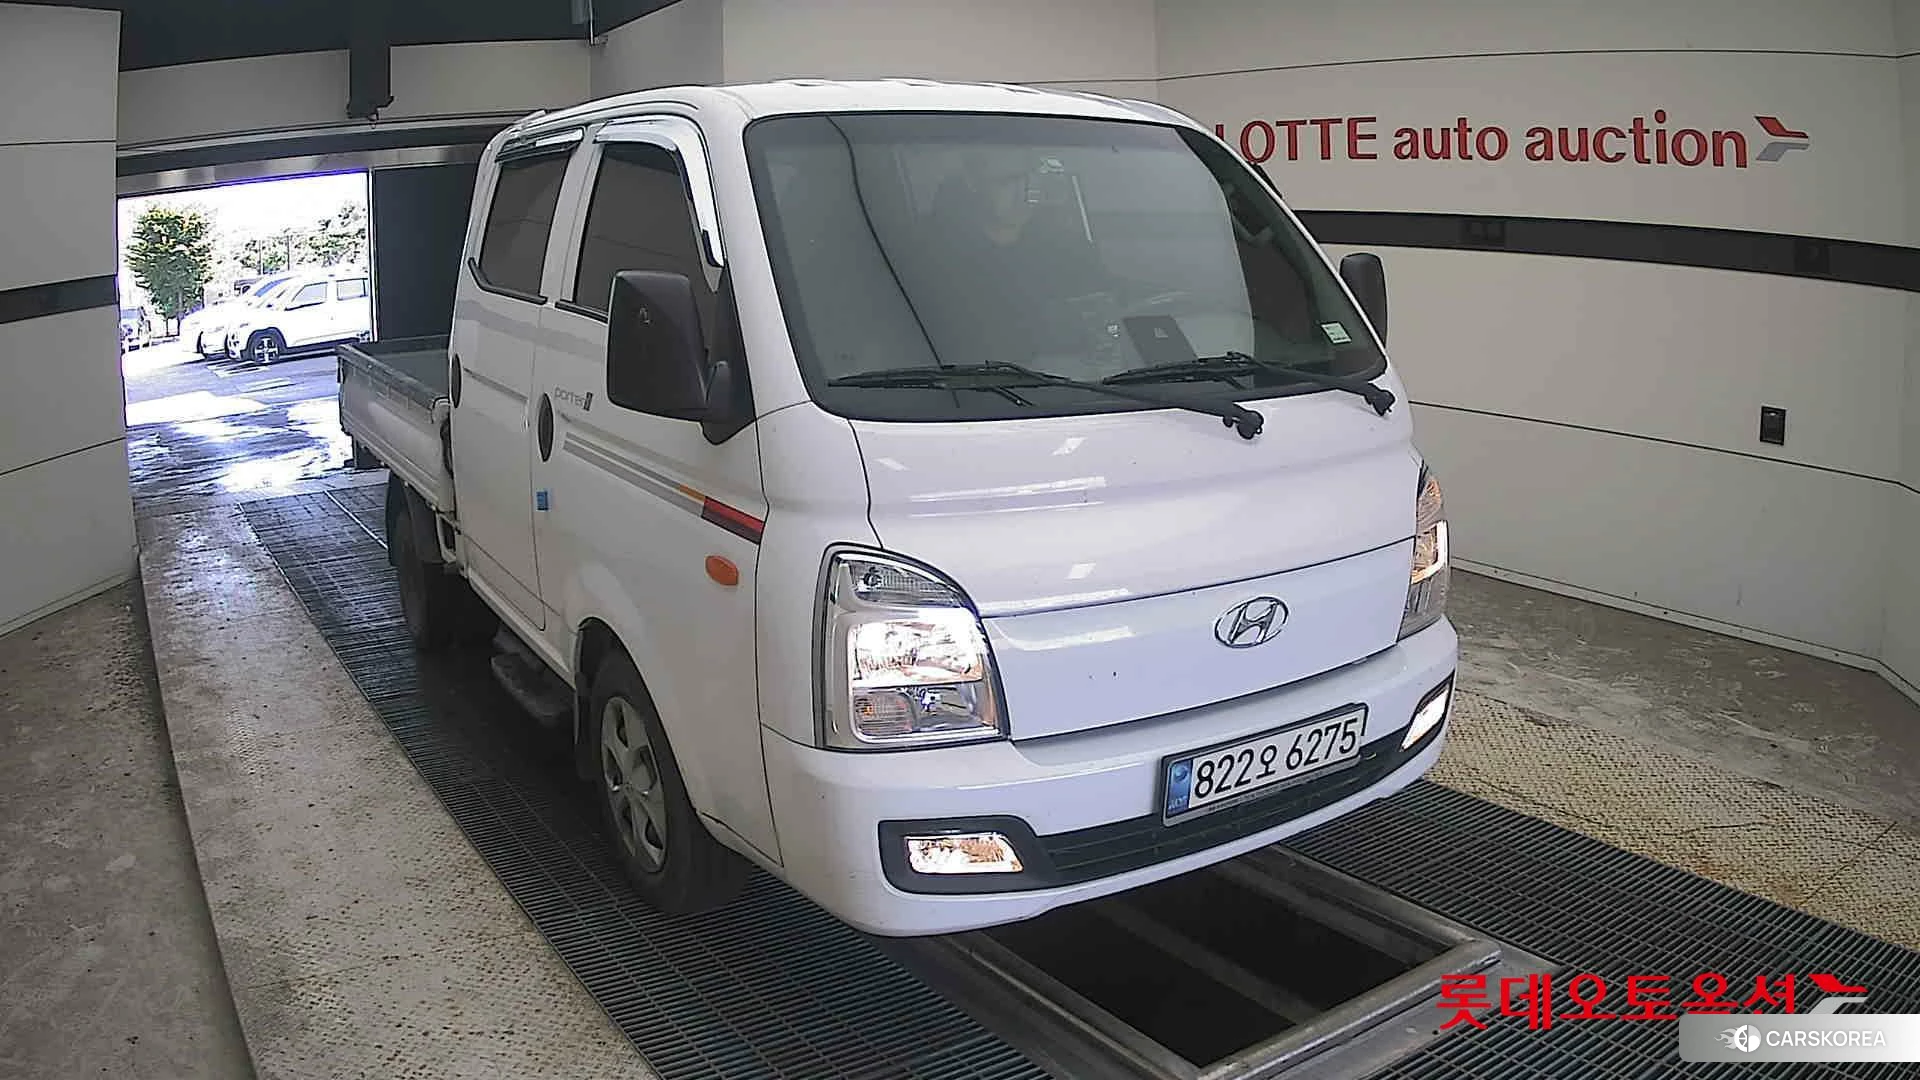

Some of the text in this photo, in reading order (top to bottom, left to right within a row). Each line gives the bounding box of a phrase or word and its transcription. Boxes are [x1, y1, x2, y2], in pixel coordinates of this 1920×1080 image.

[1393, 117, 1509, 162] auto
[1524, 109, 1748, 169] auction
[1194, 744, 1278, 799] 822오
[1285, 717, 1359, 771] 6275
